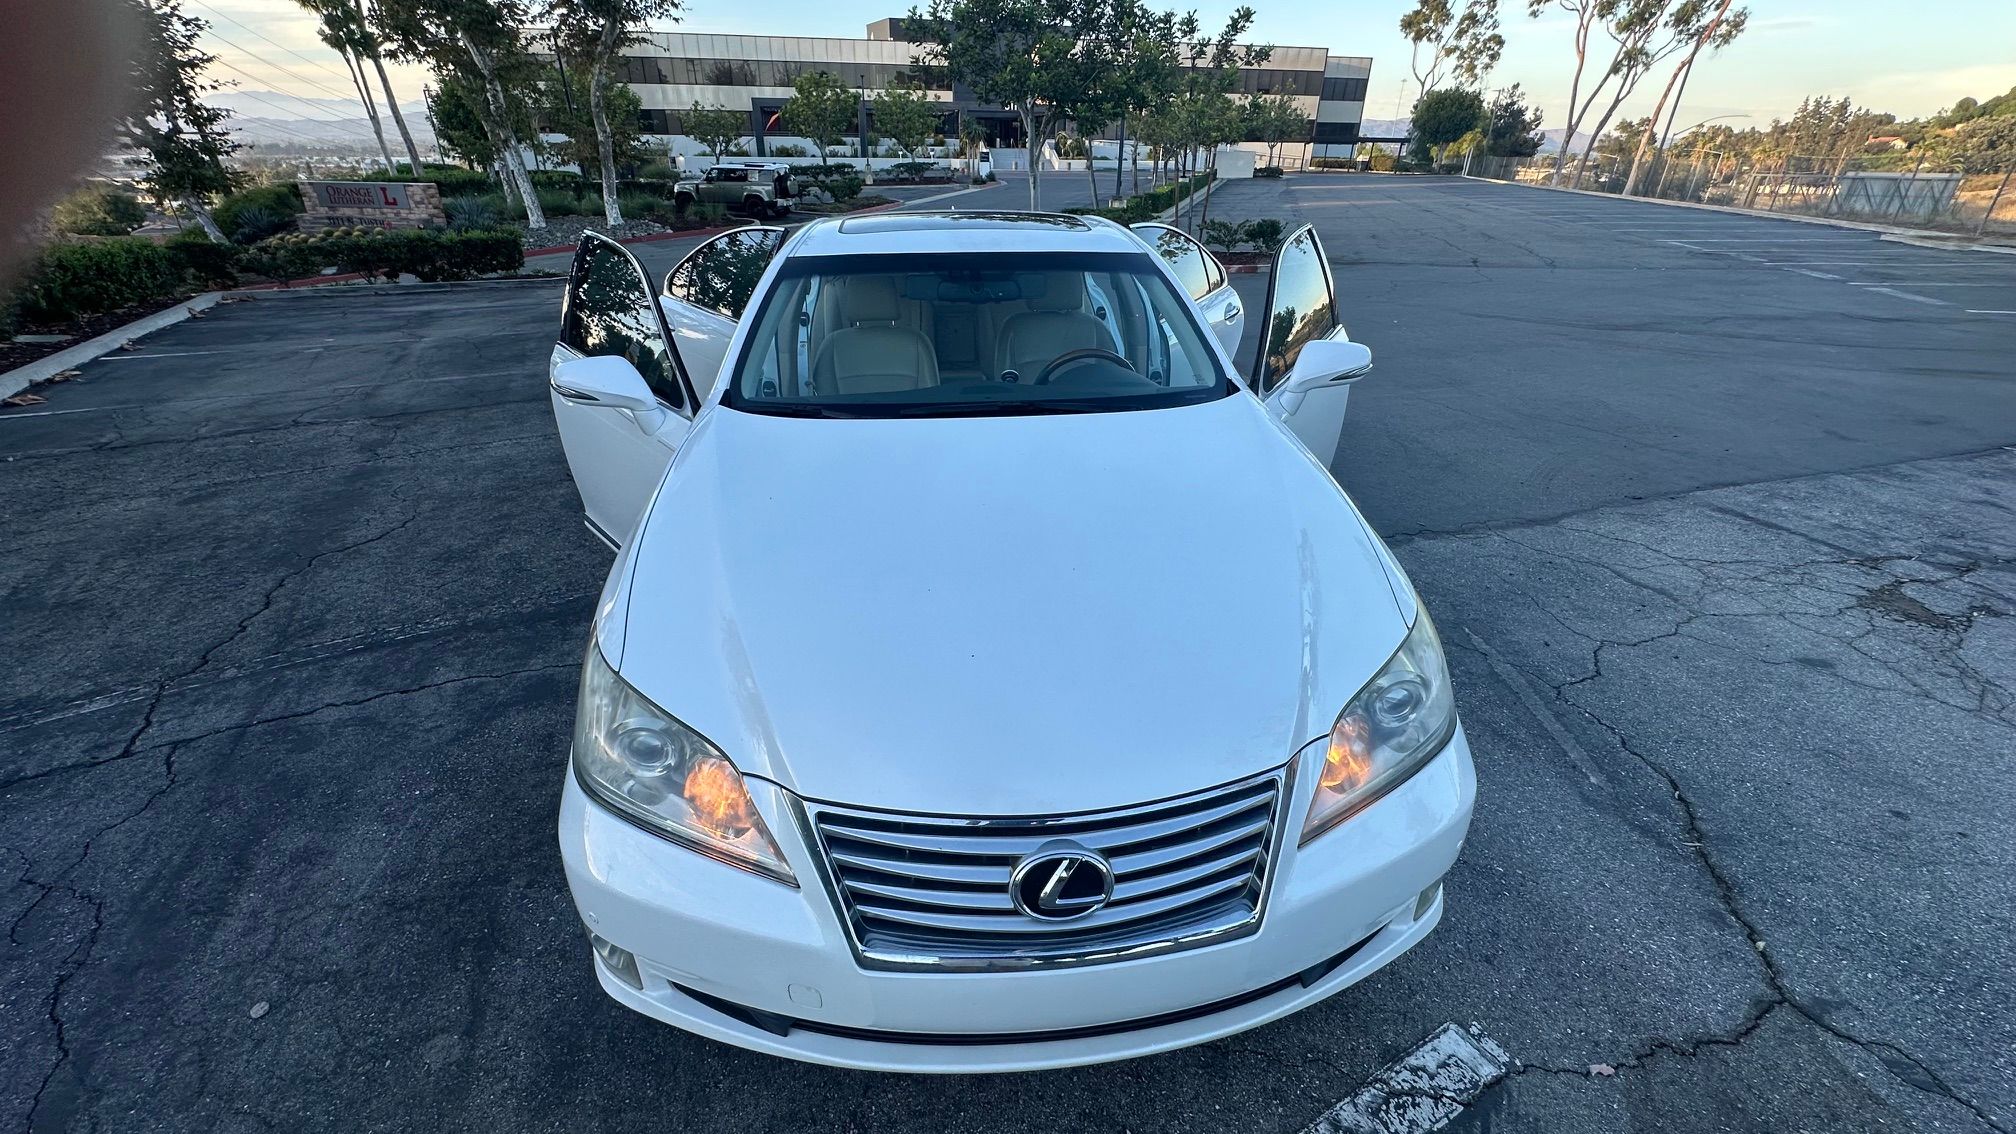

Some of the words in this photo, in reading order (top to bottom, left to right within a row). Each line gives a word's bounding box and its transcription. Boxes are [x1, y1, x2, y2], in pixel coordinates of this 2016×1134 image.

[326, 185, 373, 197] ORANGE
[380, 187, 398, 206] L
[329, 195, 375, 205] LUTHERAN
